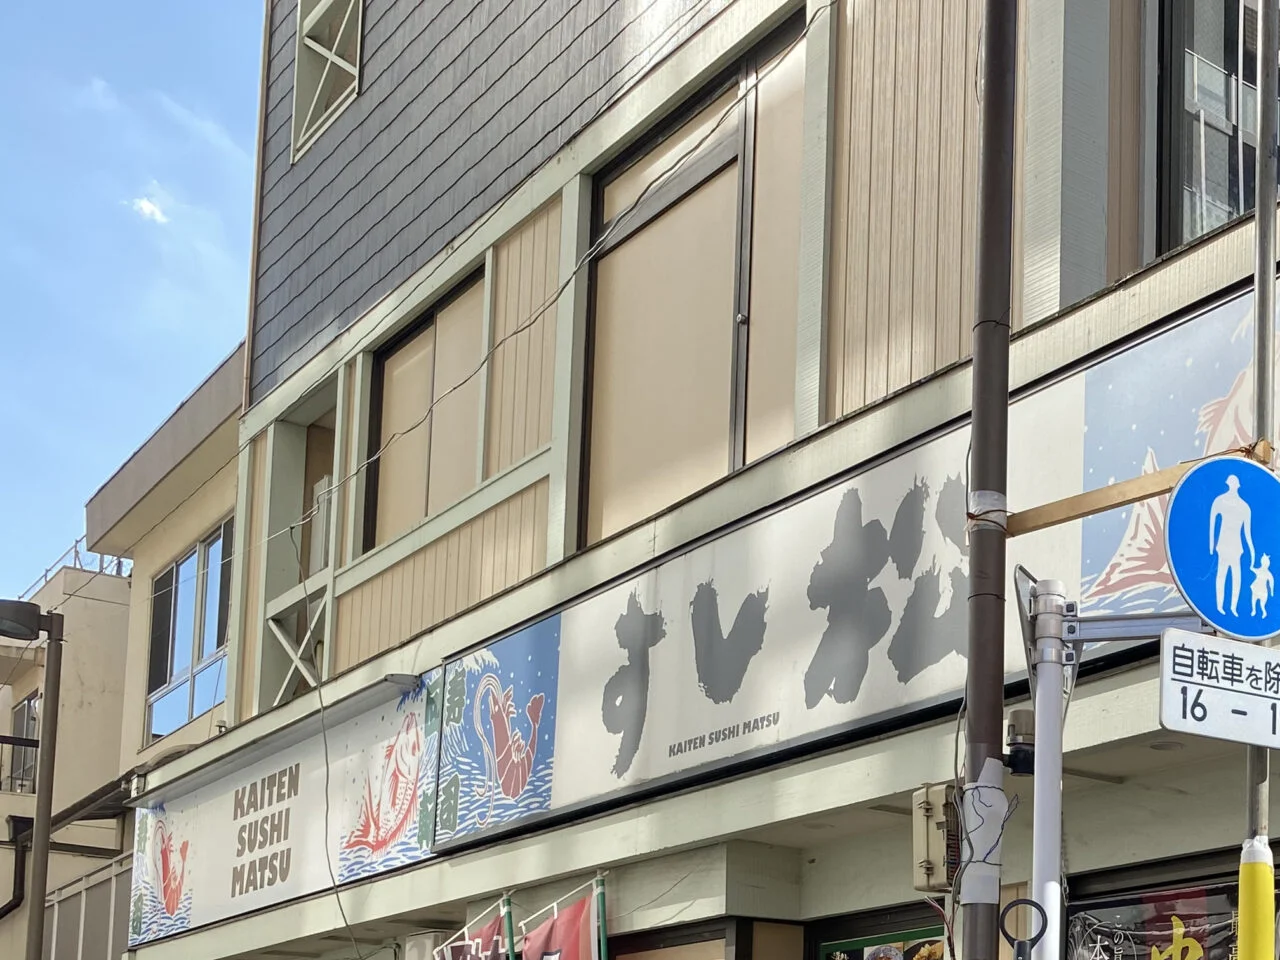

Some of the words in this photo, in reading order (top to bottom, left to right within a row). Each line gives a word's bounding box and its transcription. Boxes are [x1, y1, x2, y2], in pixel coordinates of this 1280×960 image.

[1180, 687, 1208, 722] 16
[669, 734, 705, 758] KAITEN
[708, 725, 740, 748] SUSHI
[742, 712, 780, 735] MATSU
[233, 762, 300, 821] KAITEN
[237, 808, 290, 857] SUSHI
[231, 848, 291, 898] MATSU
